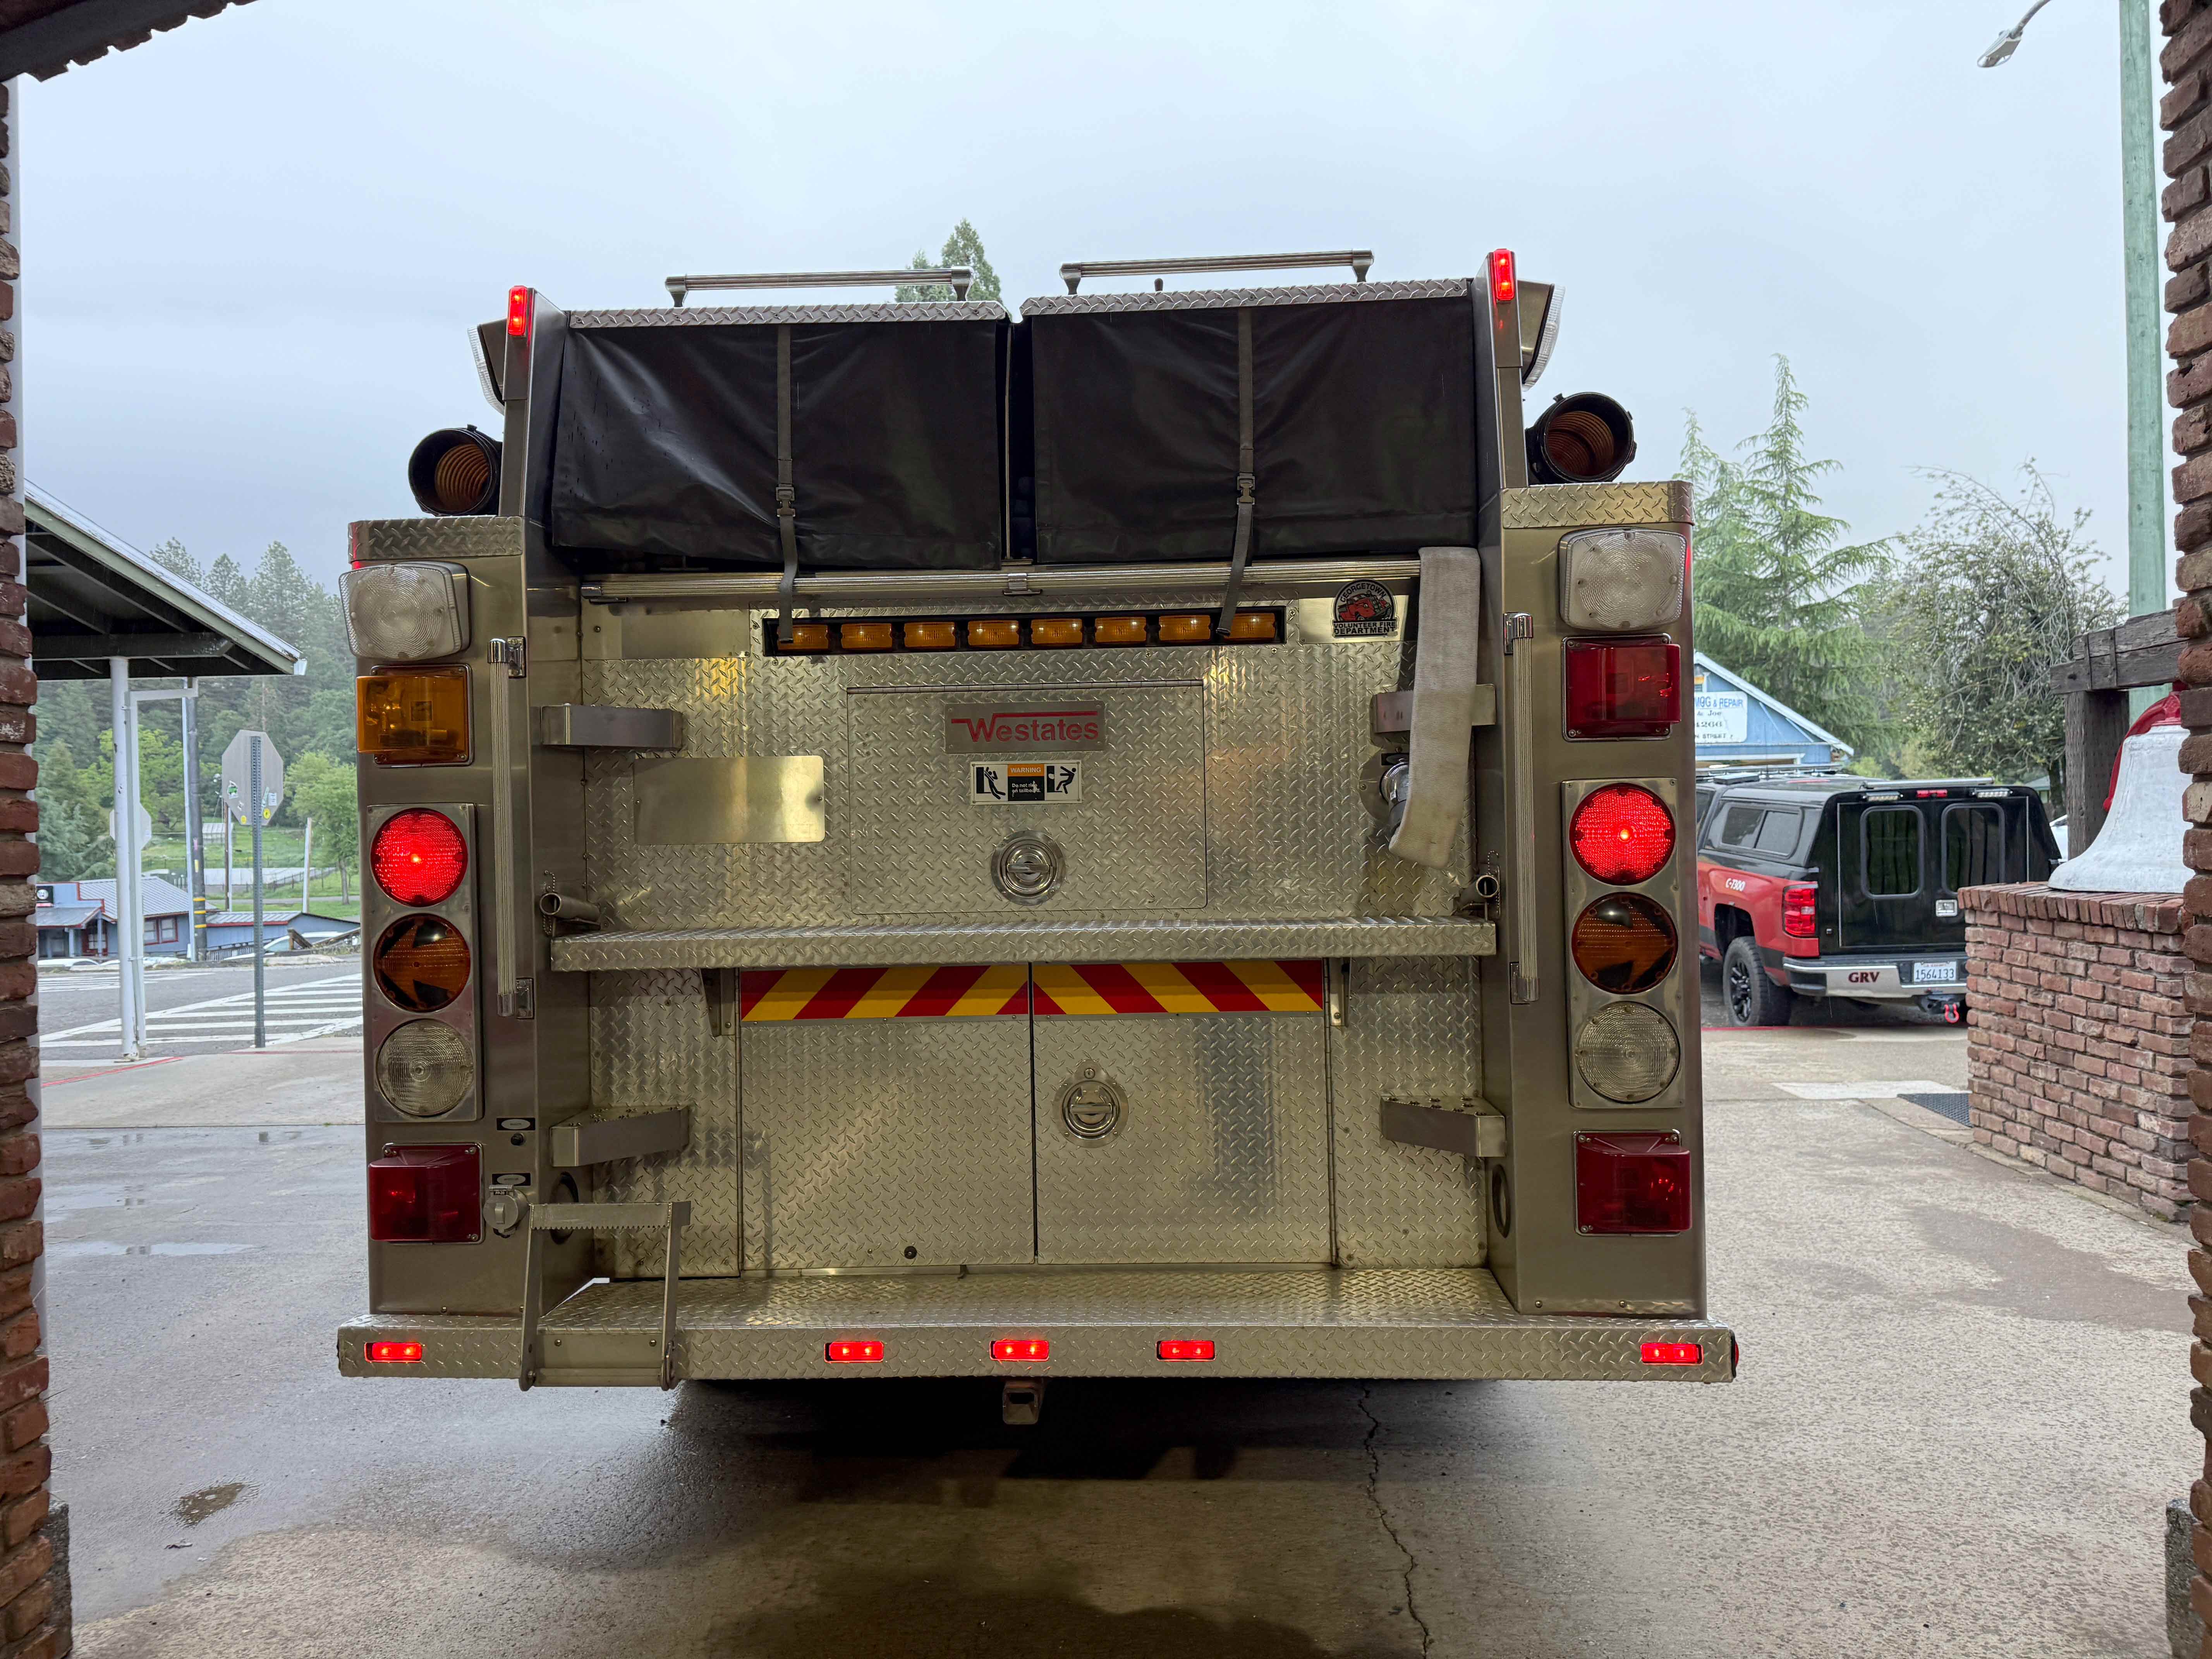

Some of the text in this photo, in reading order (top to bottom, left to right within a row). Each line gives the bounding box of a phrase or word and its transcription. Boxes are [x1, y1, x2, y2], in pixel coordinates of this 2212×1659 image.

[1340, 583, 1386, 602] GEORGETOWN
[1719, 698, 1743, 707] REPAIR
[951, 711, 1099, 742] Westates
[1848, 971, 1880, 983] GRV
[1915, 969, 1954, 980] 1564133
